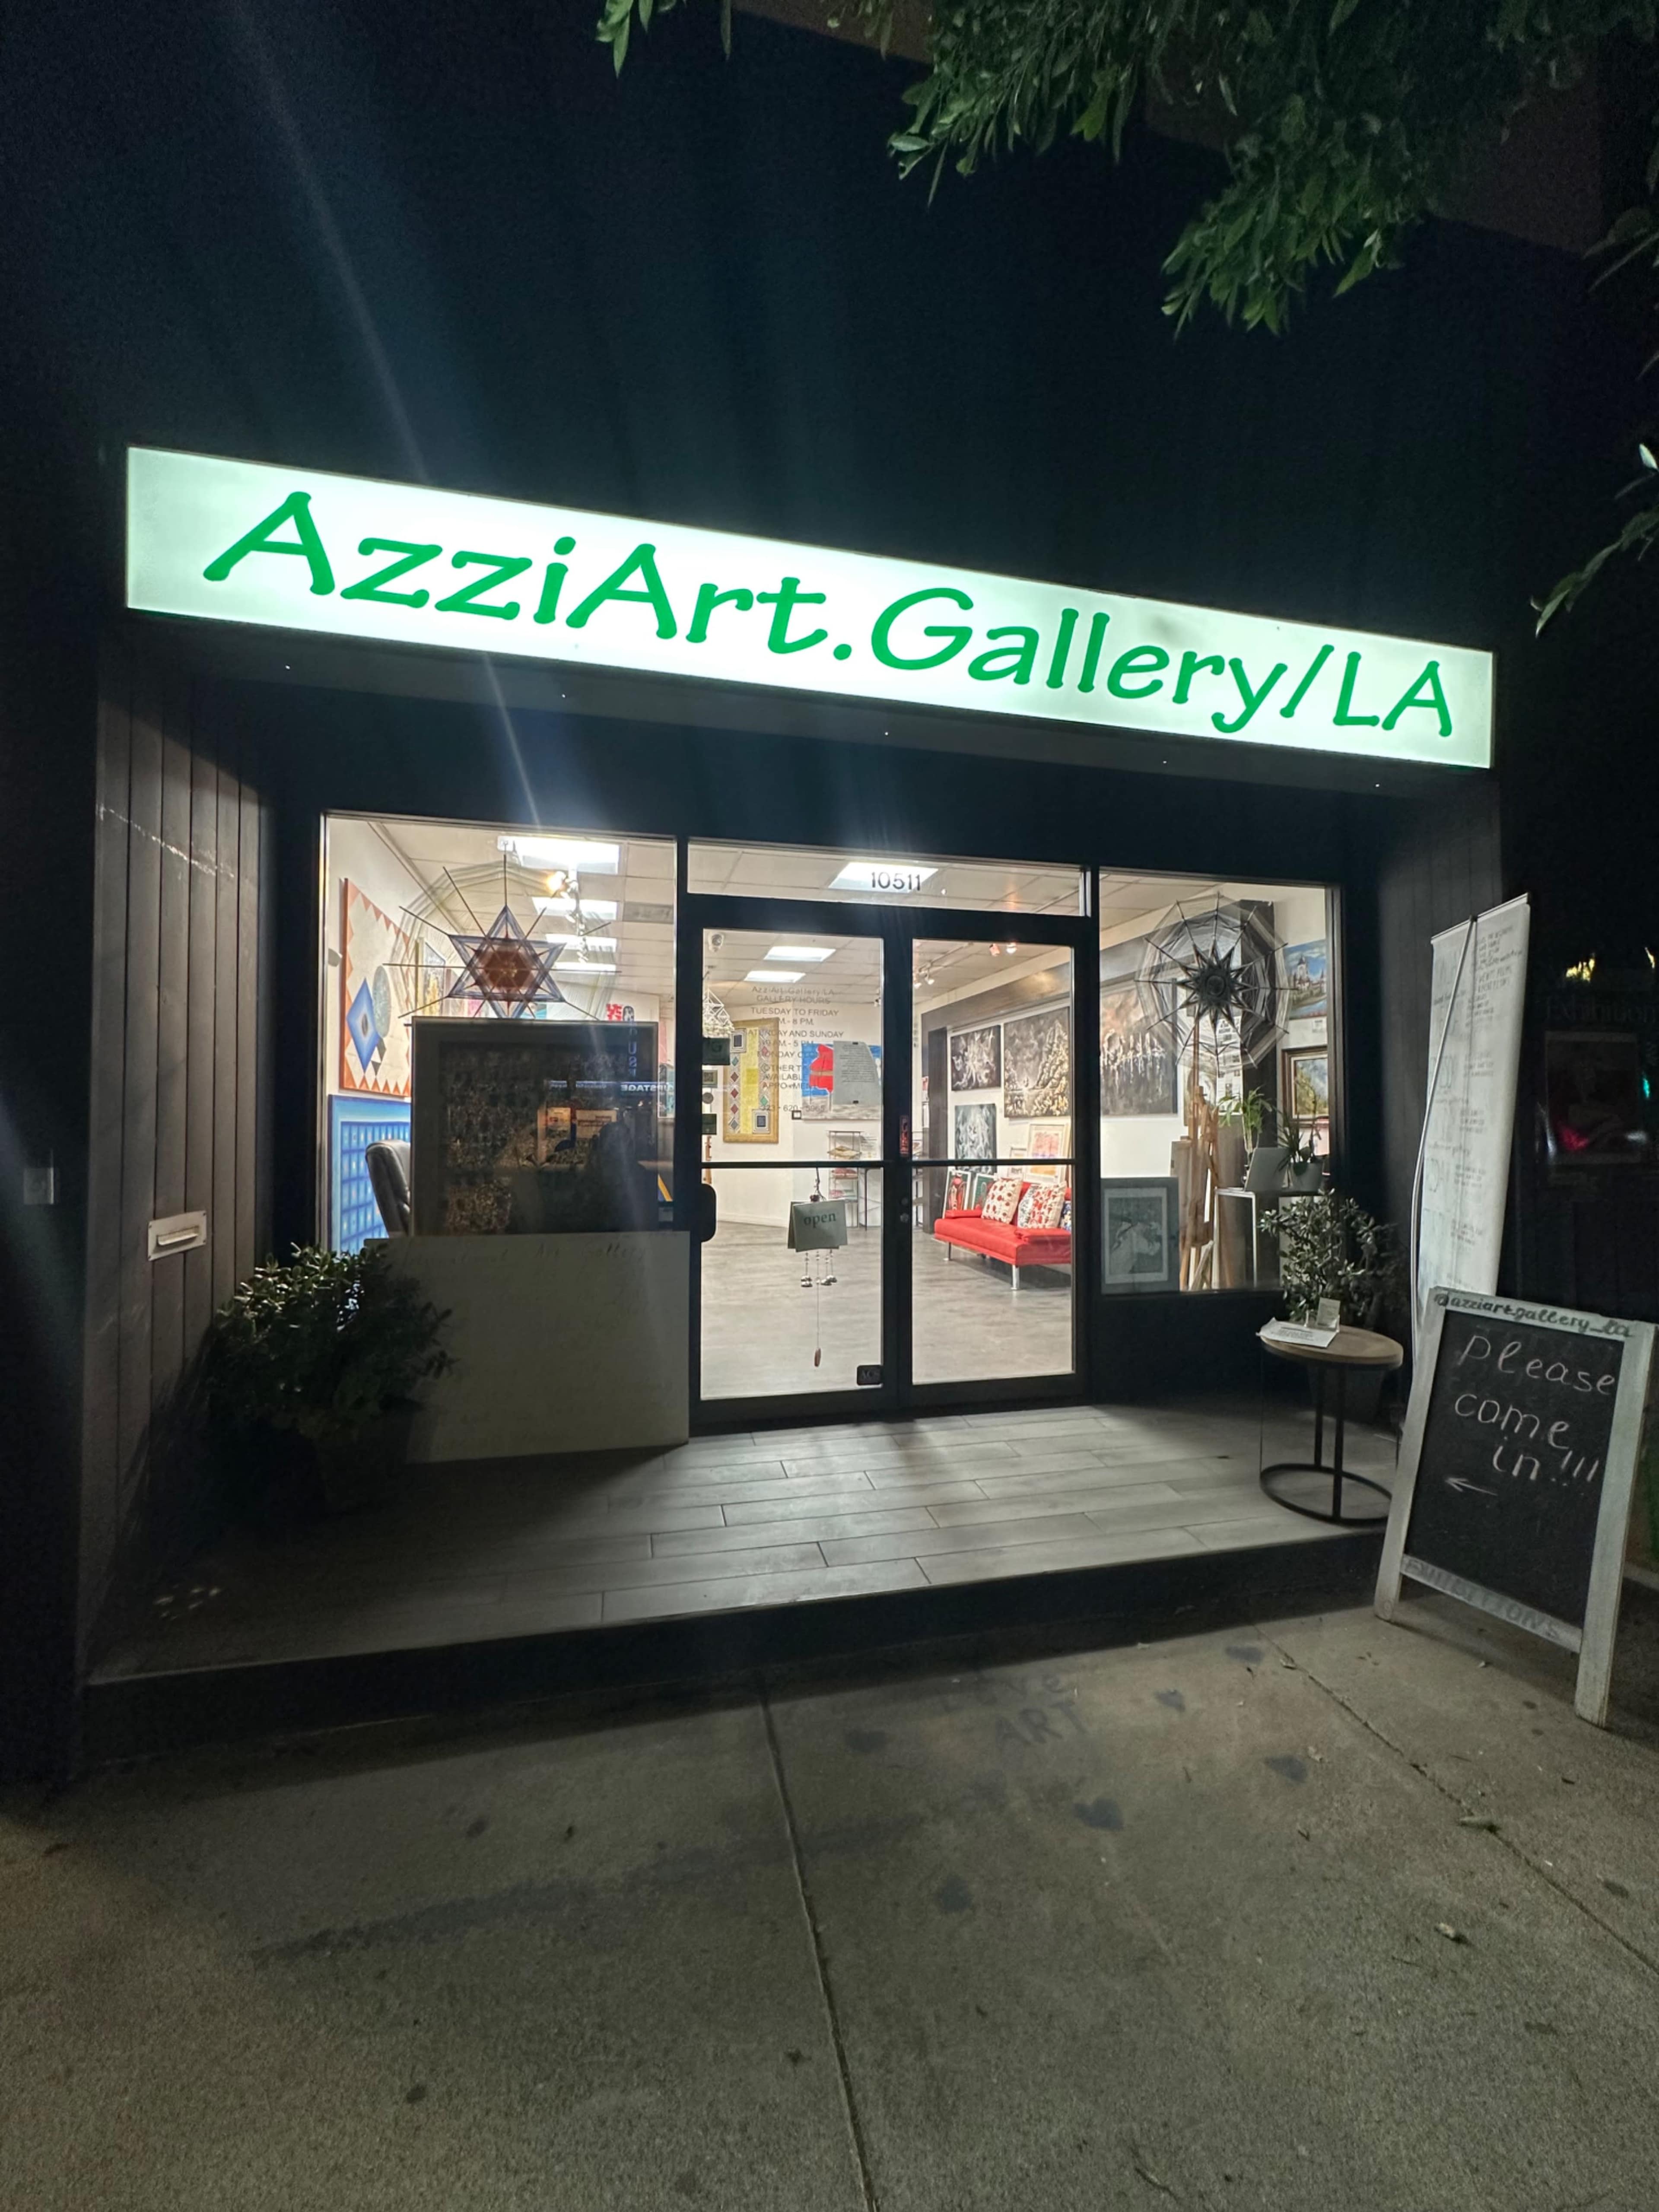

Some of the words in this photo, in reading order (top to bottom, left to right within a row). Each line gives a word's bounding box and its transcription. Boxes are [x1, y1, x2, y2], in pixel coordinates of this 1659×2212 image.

[871, 872, 920, 891] 10511
[809, 1030, 844, 1038] SUNDAY
[802, 1212, 837, 1229] open
[1454, 1392, 1571, 1450] come
